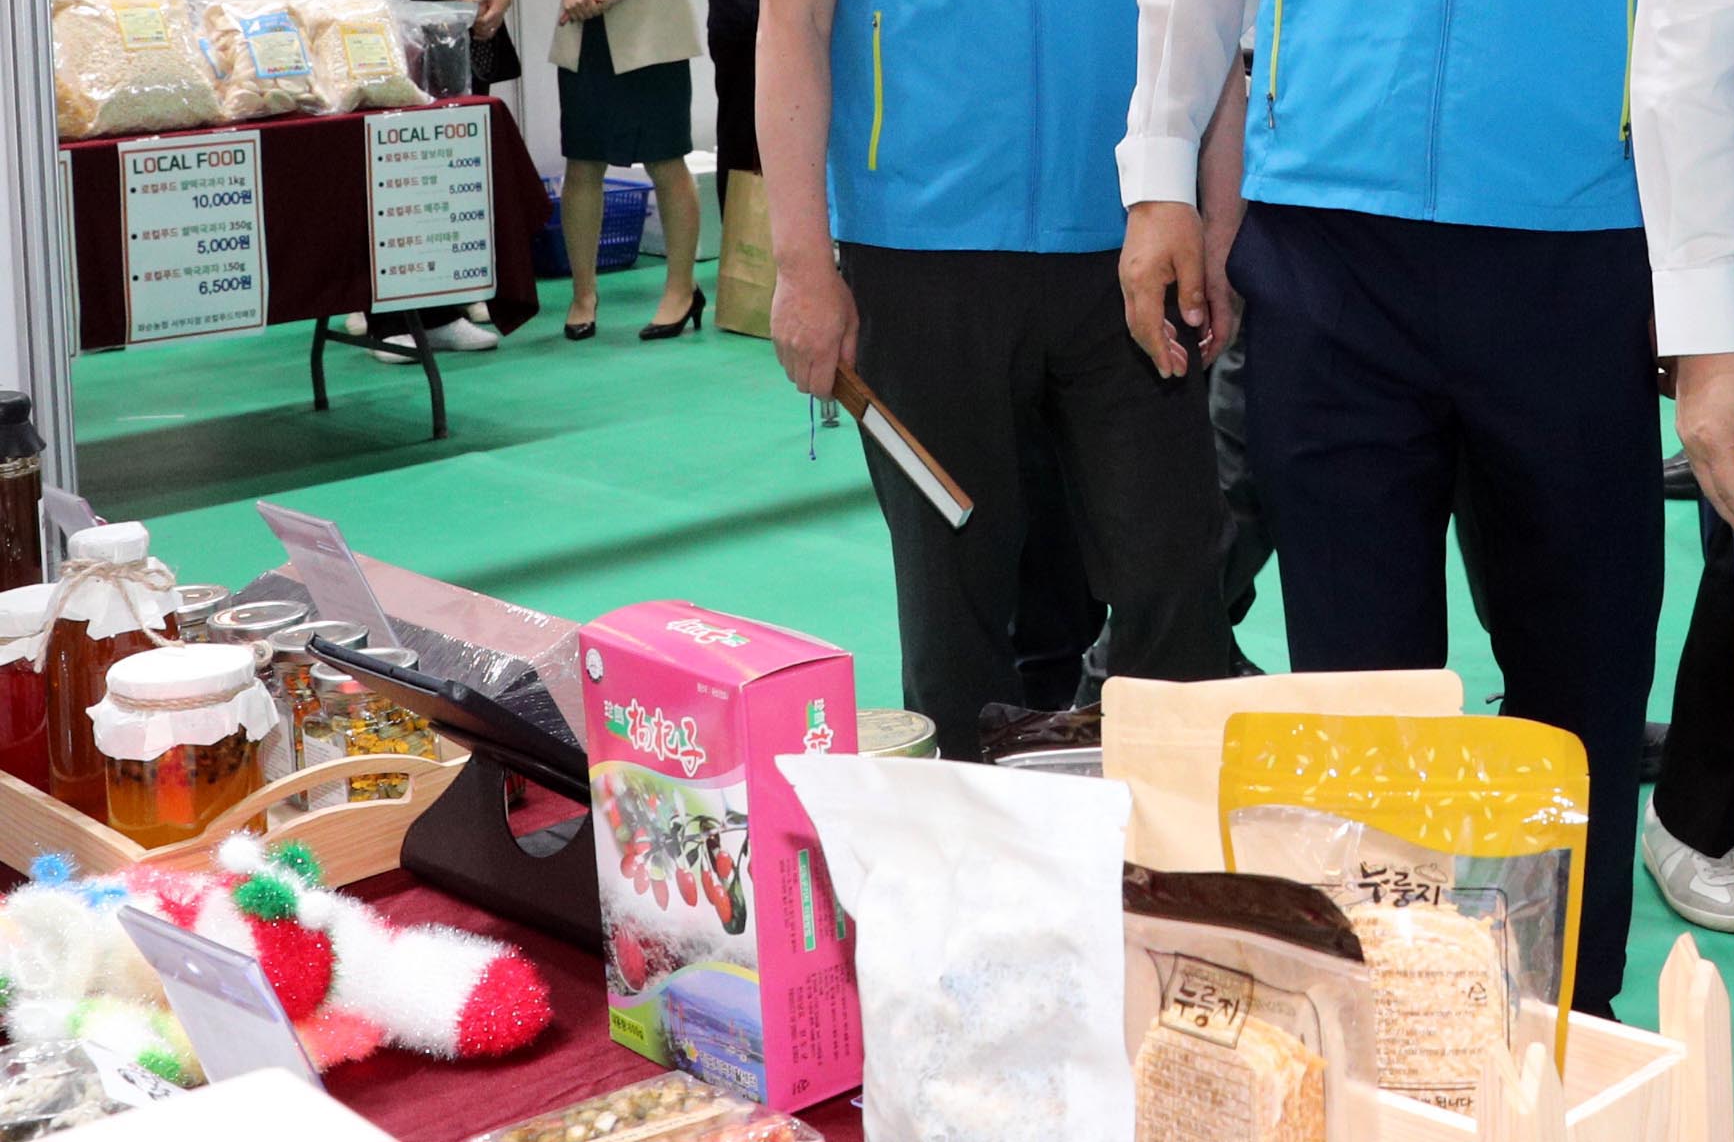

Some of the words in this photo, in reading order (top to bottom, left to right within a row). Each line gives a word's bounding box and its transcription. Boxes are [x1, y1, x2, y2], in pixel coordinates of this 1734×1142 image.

[378, 126, 431, 145] LOCAL
[434, 122, 478, 140] FOOD
[133, 154, 192, 174] LOCAL
[196, 149, 246, 168] FOOD
[142, 181, 178, 194] 로컬푸드
[228, 176, 245, 187] 1kg
[192, 189, 252, 209] 10,000원
[142, 228, 178, 241] 로컬푸드
[229, 220, 253, 232] 350g
[197, 234, 251, 254] 5,000원
[144, 268, 181, 282] 로컬푸드
[223, 262, 246, 273] 150g
[199, 274, 252, 295] 6,500원
[1358, 861, 1440, 907] 누룽지
[1173, 982, 1240, 1027] 누룽지
